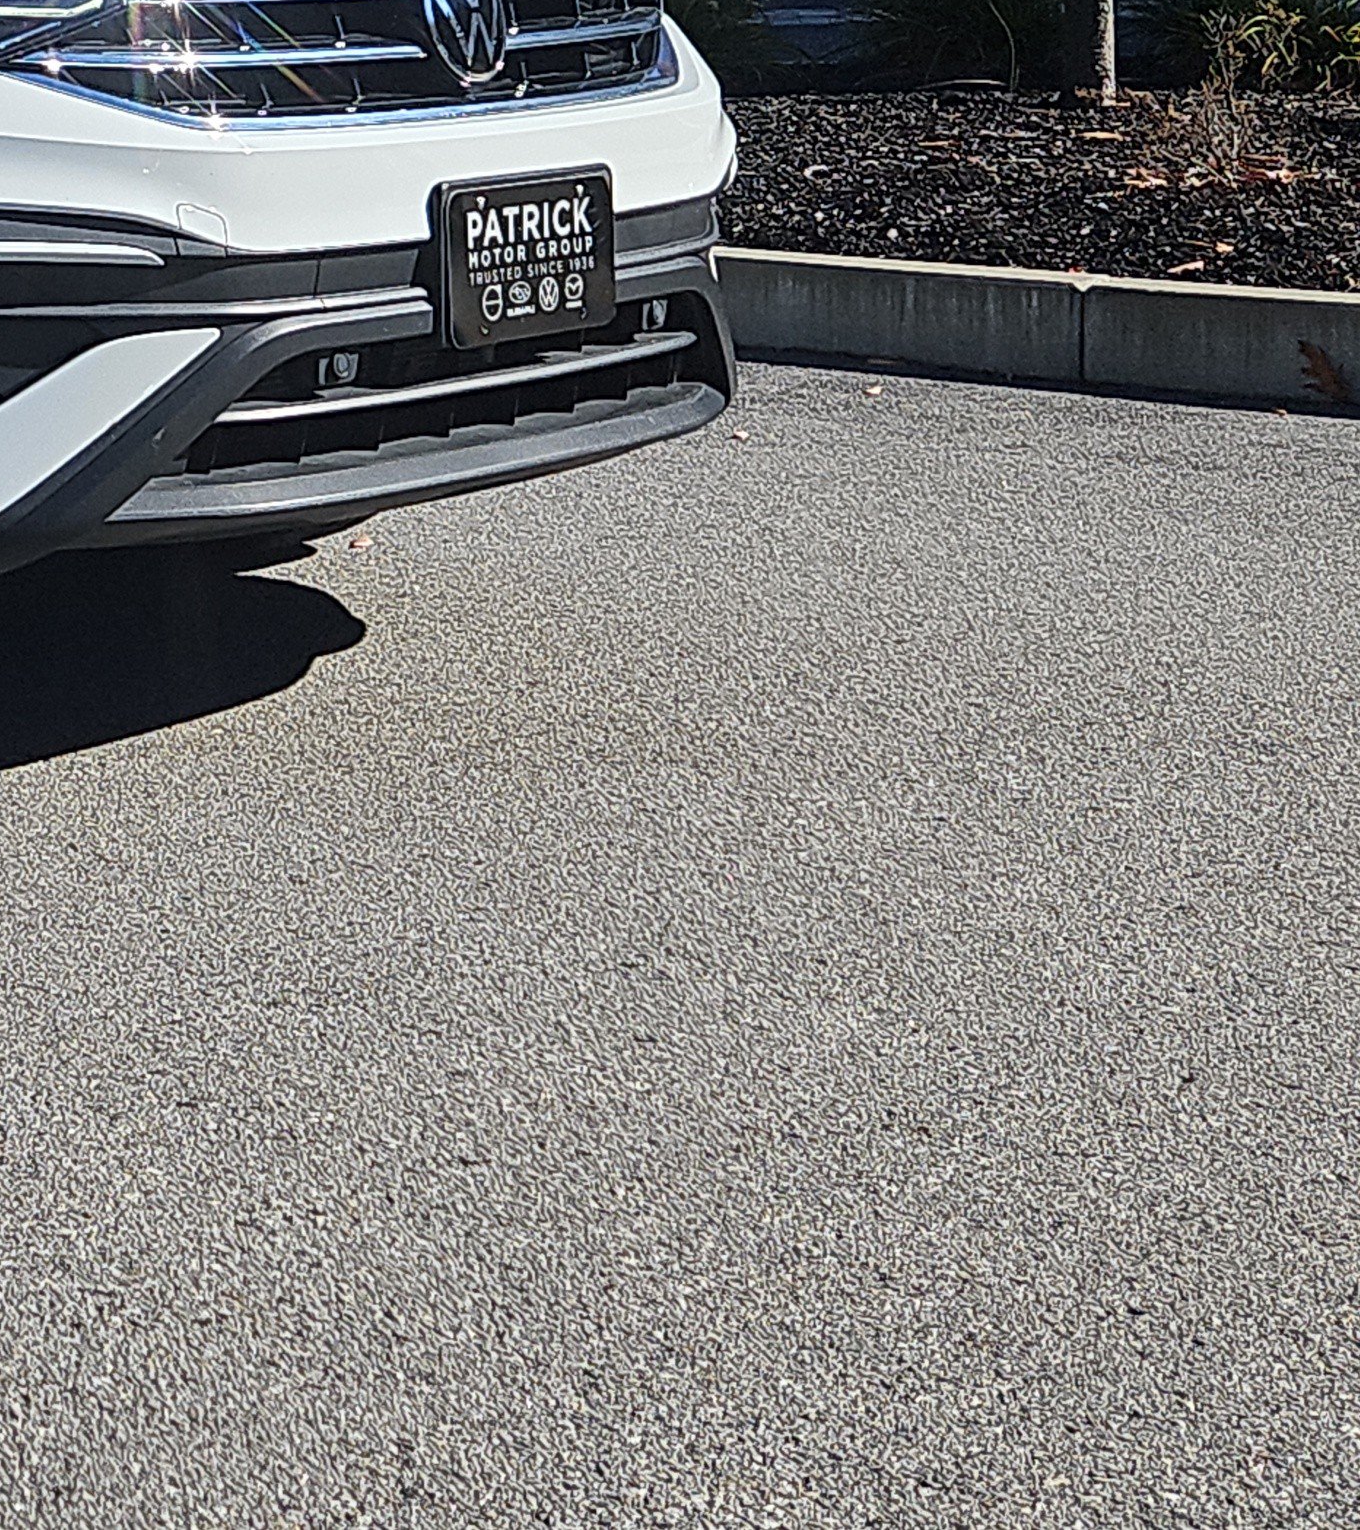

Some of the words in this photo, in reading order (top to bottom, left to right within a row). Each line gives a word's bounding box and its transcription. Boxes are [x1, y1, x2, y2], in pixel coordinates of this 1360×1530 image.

[466, 196, 593, 250] PATRICK
[468, 244, 527, 270] MOTOR
[535, 235, 593, 259] GROUP
[469, 266, 522, 286] TRUSTED
[527, 260, 564, 278] SINCE
